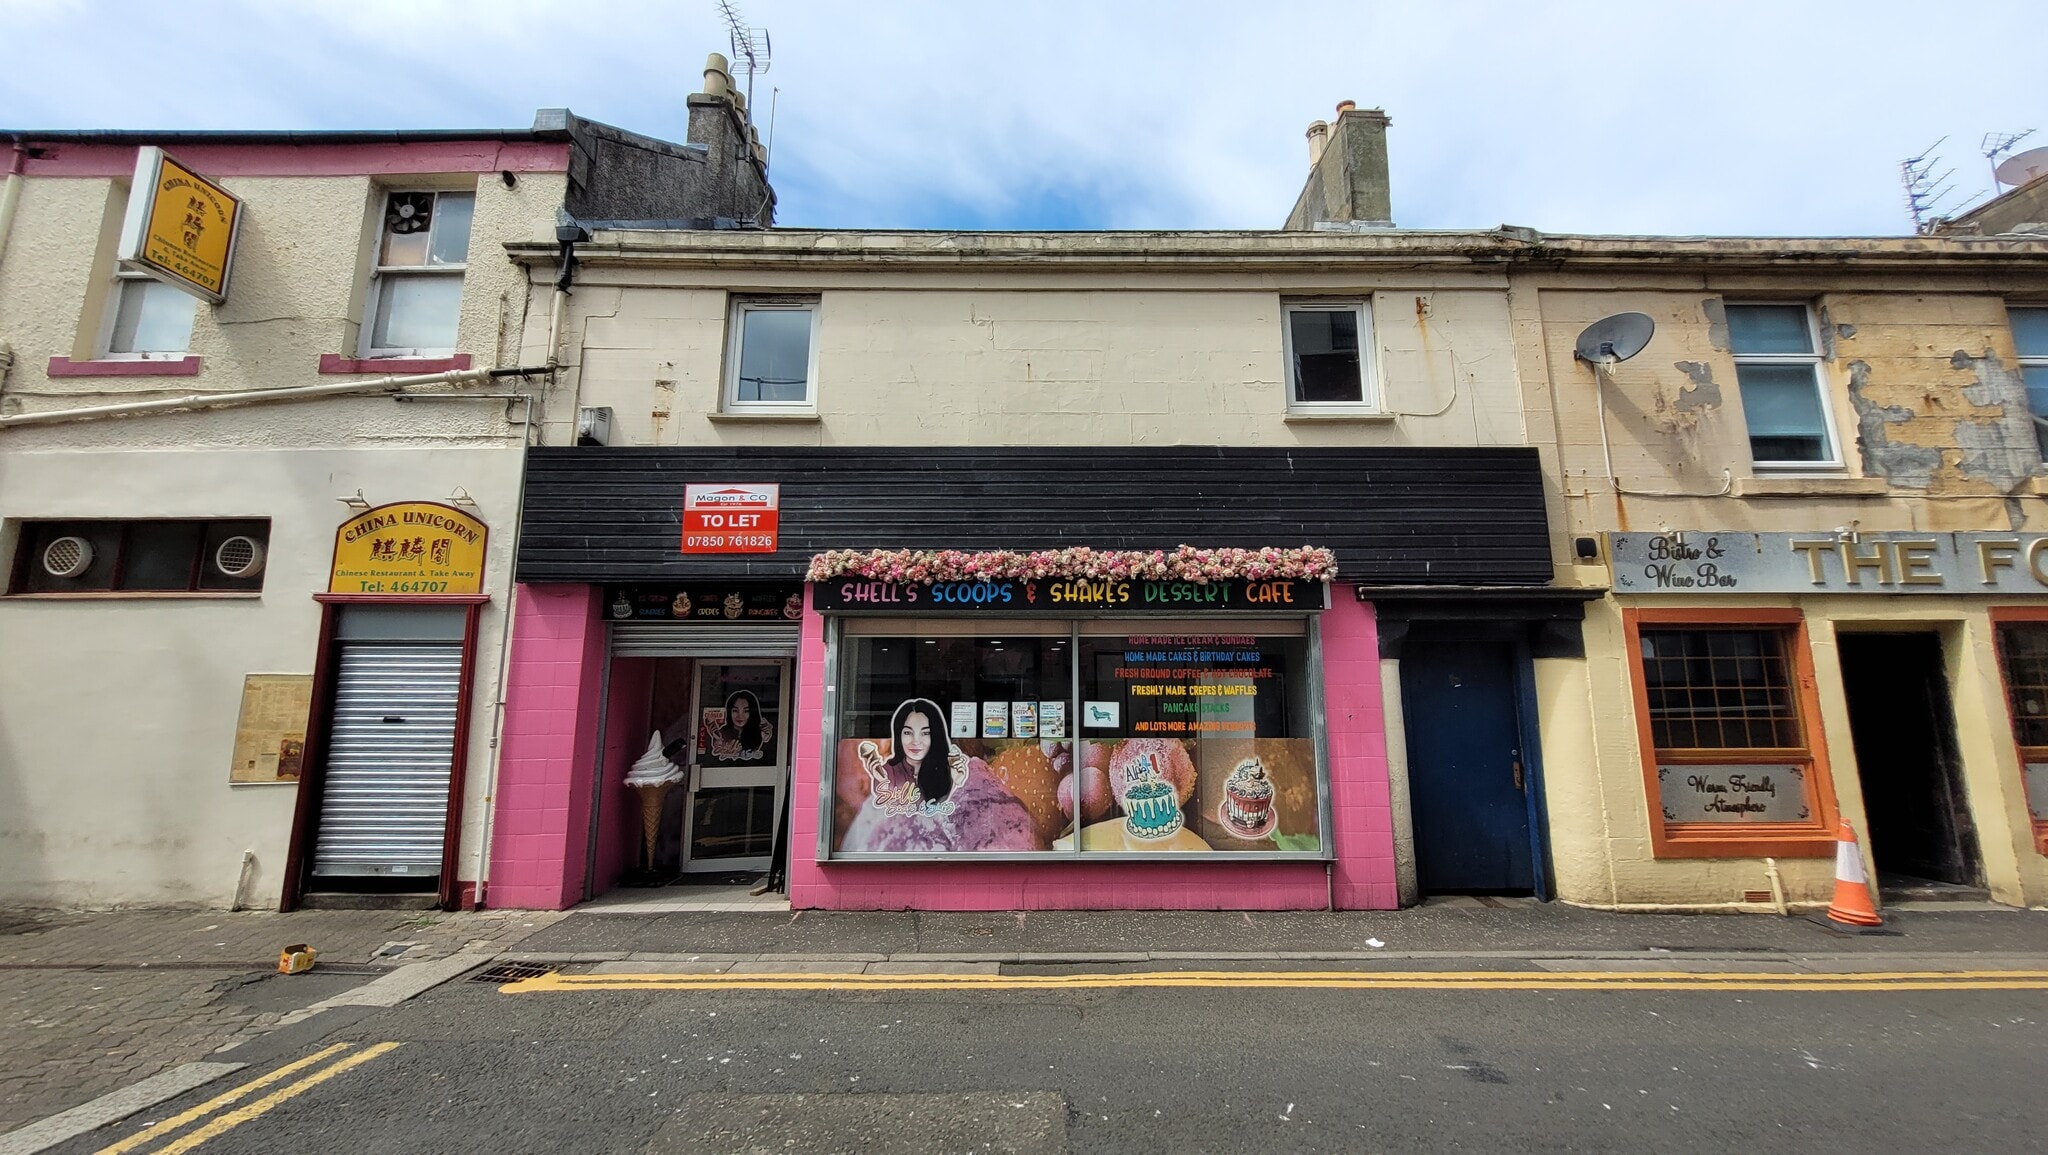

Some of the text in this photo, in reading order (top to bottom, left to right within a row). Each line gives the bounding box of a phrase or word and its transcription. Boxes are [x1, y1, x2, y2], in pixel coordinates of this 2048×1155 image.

[163, 178, 228, 224] CHINA UNICORN
[152, 249, 215, 286] Tel: 464707
[701, 514, 761, 527] TO LET
[344, 512, 480, 545] CHINA UNICORN
[687, 536, 772, 547] 07850 761826
[1648, 536, 1727, 561] Bistro &
[1788, 538, 1943, 585] THE
[335, 569, 475, 579] Chinese Restaurant & Take Away
[1644, 563, 1738, 588] Wine Bar
[360, 580, 448, 592] Tel: 464707
[931, 583, 1013, 603] SCOOPS
[1026, 583, 1037, 604] &
[1050, 583, 1130, 603] SHAKES
[1144, 582, 1232, 603] DESSERT
[1246, 582, 1295, 603] CAFE
[1128, 635, 1150, 645] HOME
[1151, 635, 1172, 645] MADE
[1187, 635, 1214, 645] CREAM
[1125, 651, 1145, 662] HOME
[1146, 651, 1167, 662] MADE
[1168, 651, 1192, 662] CAKES
[1193, 650, 1199, 663] &
[1236, 651, 1260, 662] CAKES
[1114, 668, 1139, 679] FRESH
[1140, 668, 1171, 679] GROUND
[1172, 668, 1201, 679] COFFEE
[1211, 668, 1227, 679] HOT
[1229, 668, 1273, 679] CHOCOLATE
[1131, 684, 1258, 697] FRESHLY MADE CREPES & WAFFLES
[1163, 702, 1199, 713] PANCAKE
[1135, 721, 1149, 731] AND
[1150, 721, 1167, 731] LOTS
[1168, 721, 1187, 731] MORE
[1728, 774, 1776, 798] Friendly
[1703, 794, 1767, 818] Atmosphere
